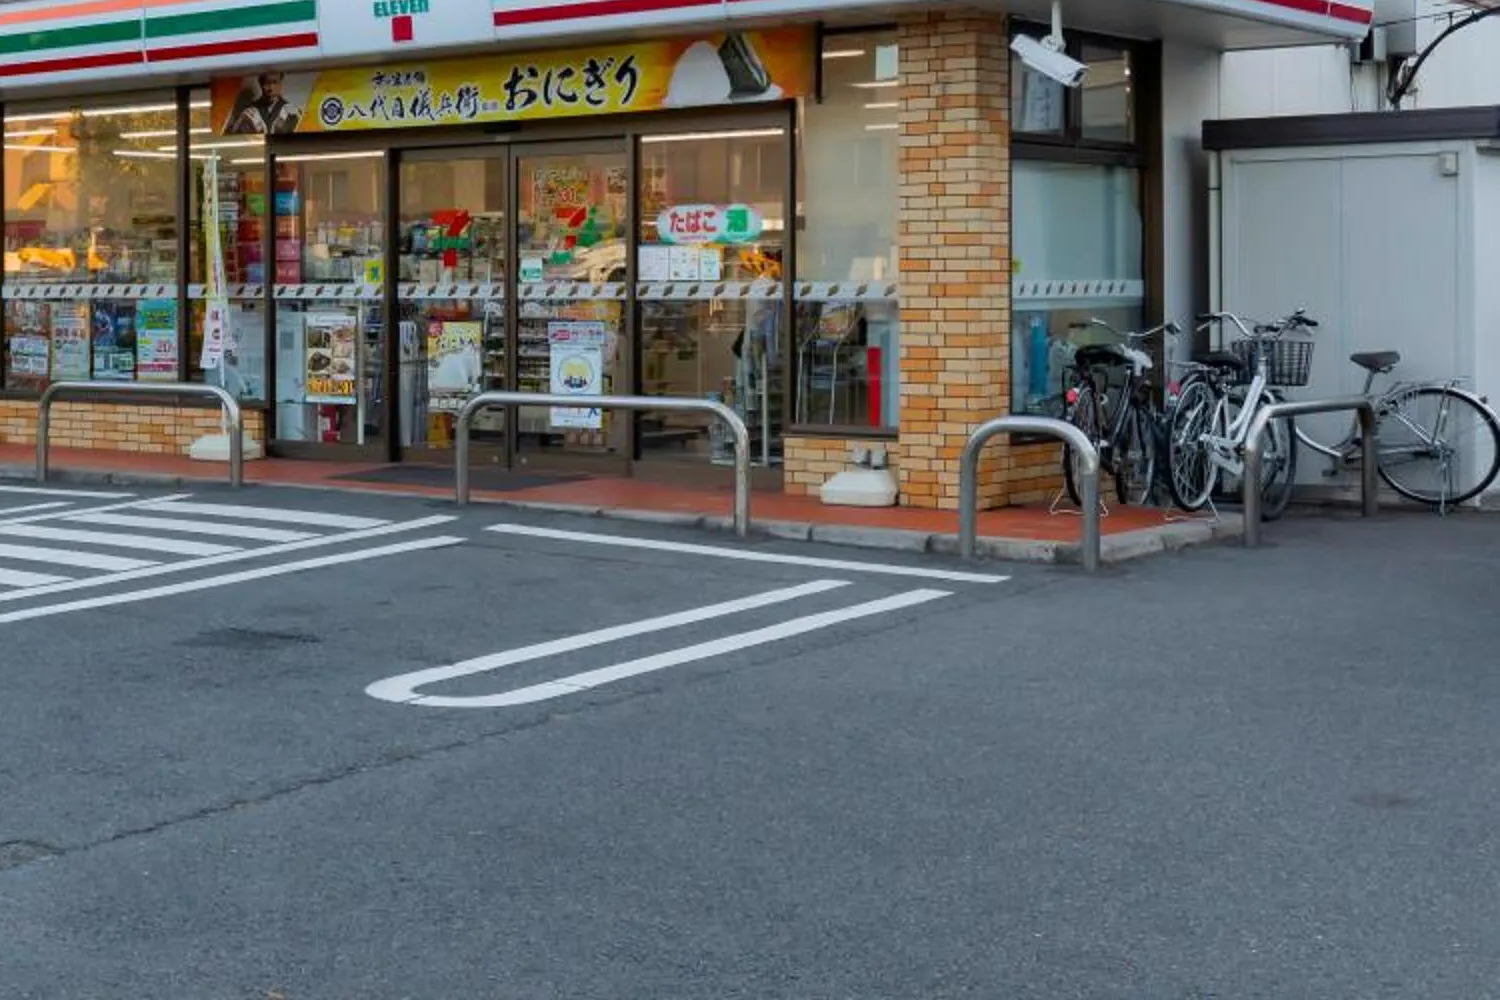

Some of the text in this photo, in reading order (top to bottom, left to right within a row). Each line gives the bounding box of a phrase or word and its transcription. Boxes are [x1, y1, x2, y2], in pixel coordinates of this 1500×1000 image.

[503, 55, 640, 111] おにぎり
[669, 210, 717, 233] たばこ
